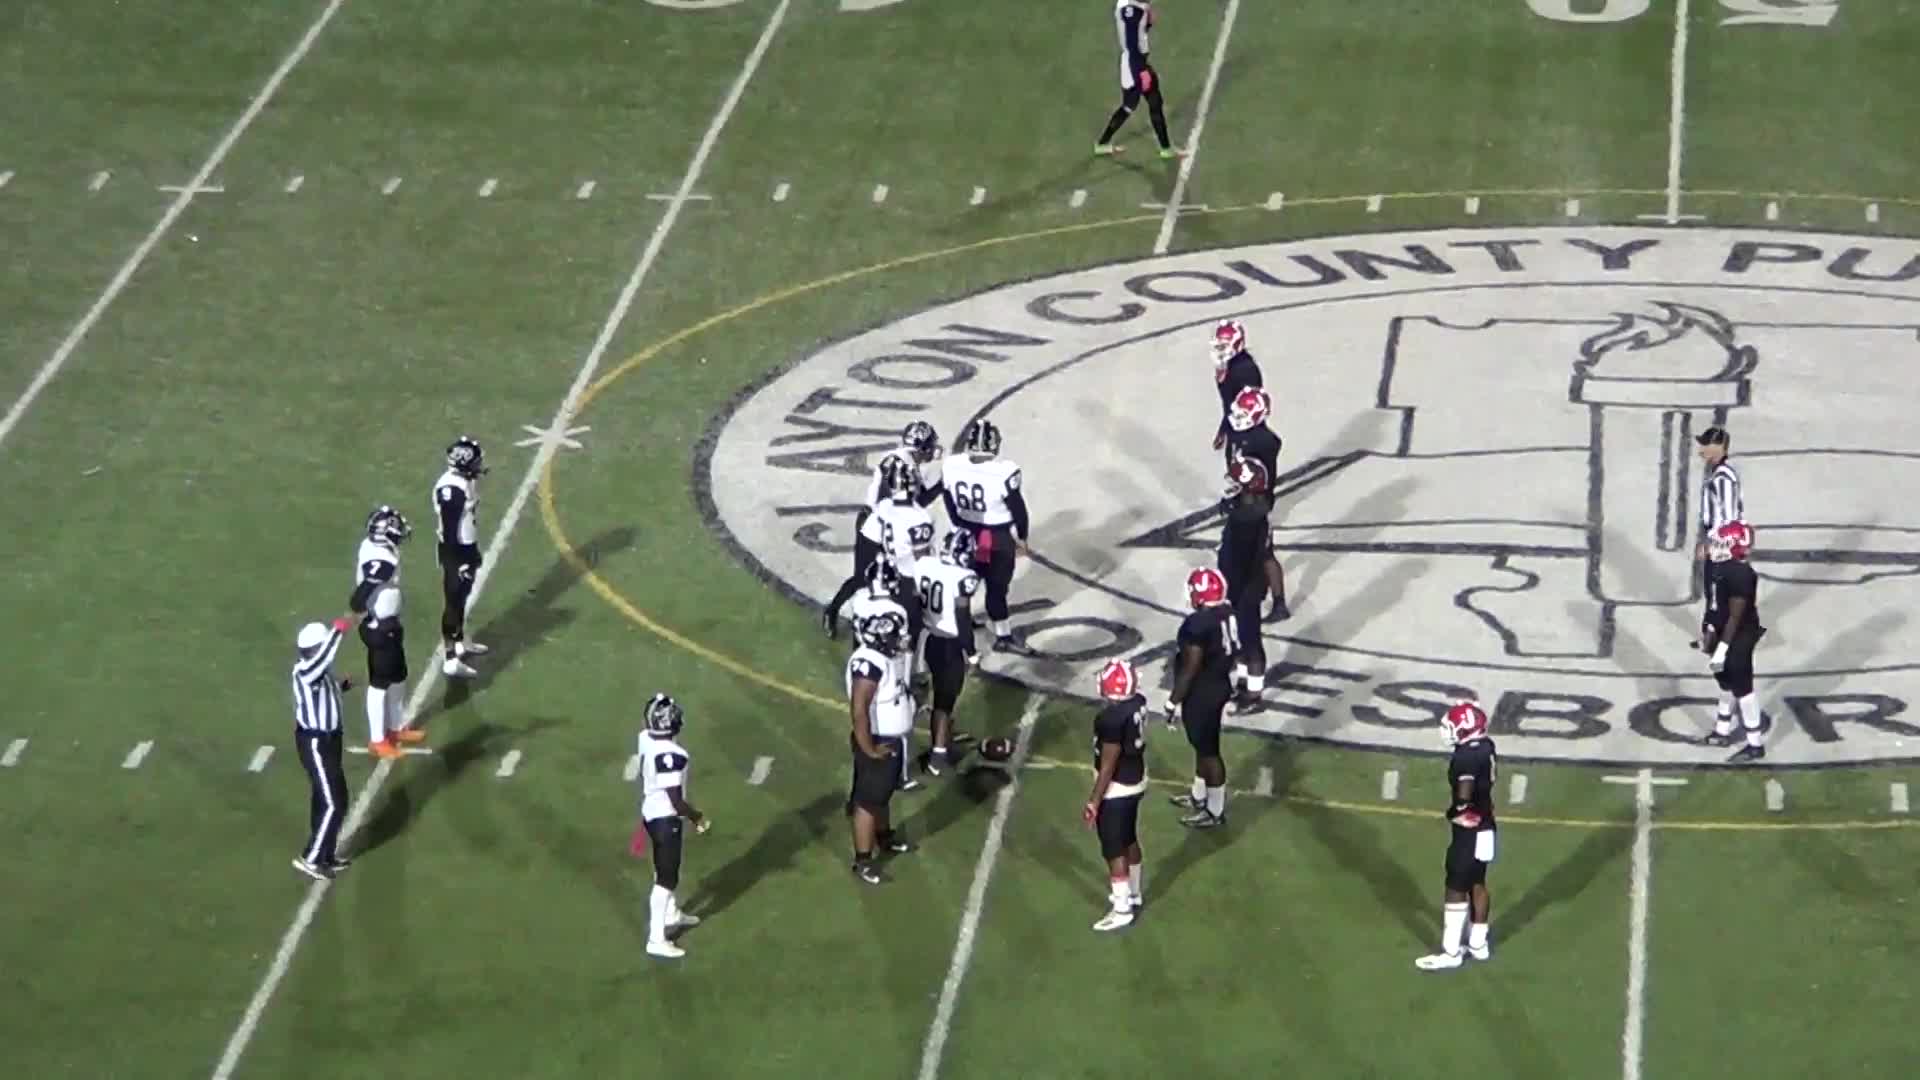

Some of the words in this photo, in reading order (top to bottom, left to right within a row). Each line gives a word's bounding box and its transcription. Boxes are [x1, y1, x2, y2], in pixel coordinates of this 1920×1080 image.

[1025, 238, 1661, 326] COUNTY
[955, 480, 987, 512] 68
[369, 561, 382, 576] 7
